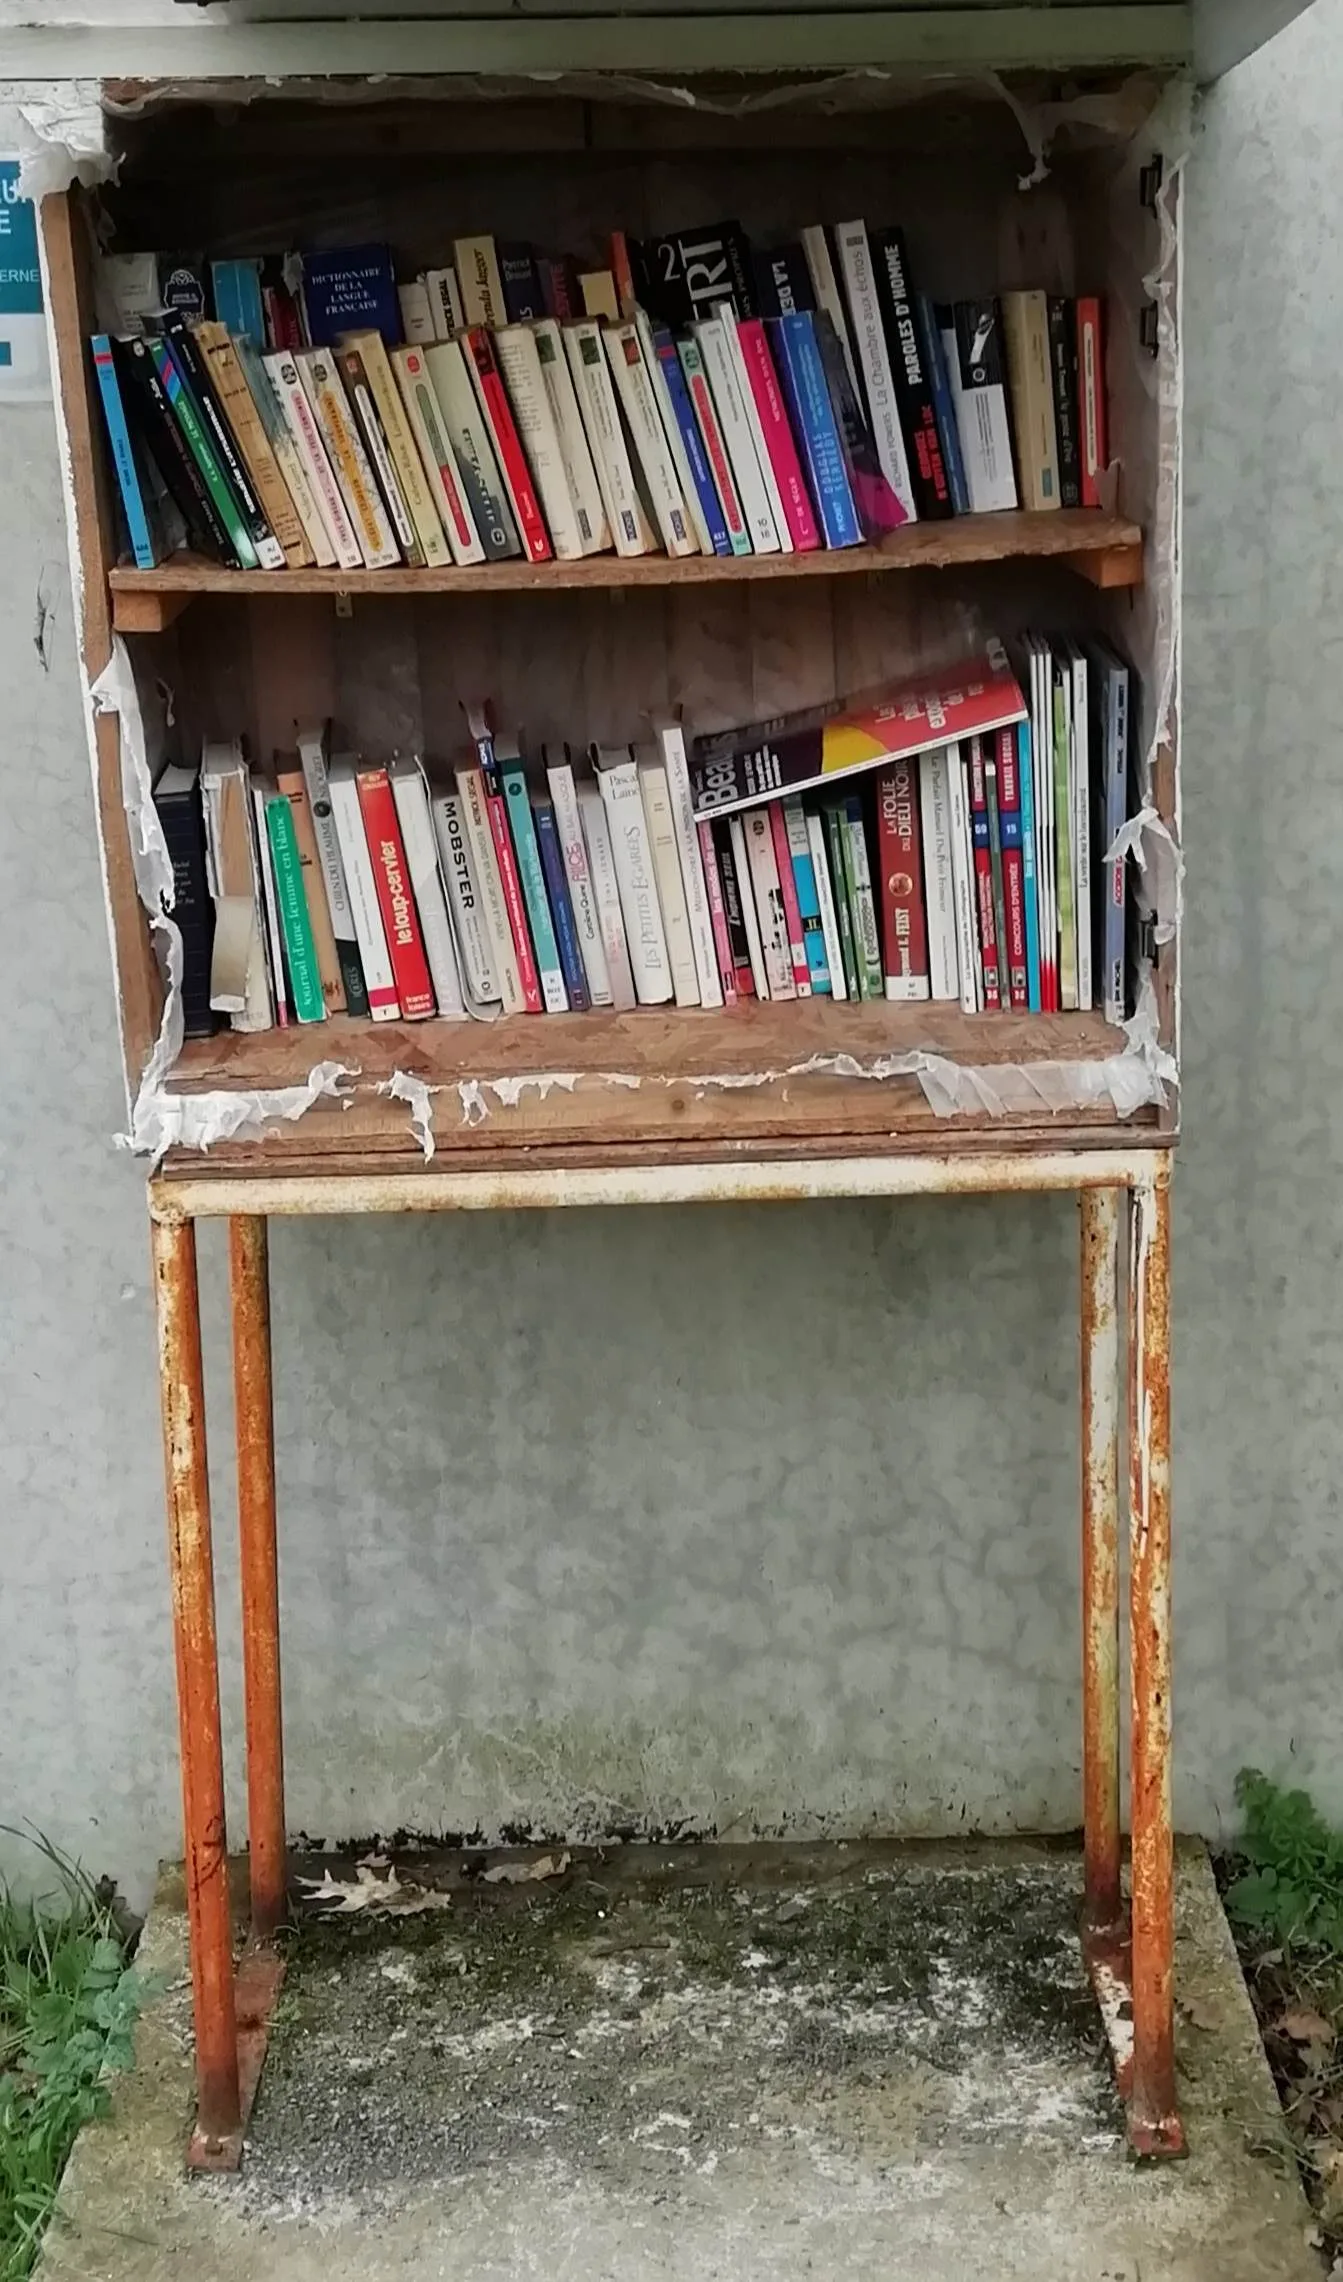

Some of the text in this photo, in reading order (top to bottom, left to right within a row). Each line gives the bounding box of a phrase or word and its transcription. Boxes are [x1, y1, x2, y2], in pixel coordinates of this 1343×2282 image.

[311, 267, 384, 286] DICTIONNAIRE
[657, 243, 681, 282] 2
[771, 261, 788, 285] LA
[852, 251, 867, 292] échos
[330, 289, 371, 304] LANGUE
[333, 280, 364, 293] DE LA
[861, 296, 872, 319] aux
[866, 325, 884, 385] Chambre
[898, 320, 921, 383] PAROLES
[876, 389, 887, 405] La
[895, 759, 909, 797] NOIR
[1002, 735, 1013, 800] TRAVAIL SOCIAL
[931, 770, 941, 800] Parfait
[882, 781, 897, 833] LA FOLIE
[897, 802, 911, 835] DIEU
[934, 802, 943, 834] Manuel
[276, 817, 287, 849] blanc
[282, 852, 291, 868] en
[445, 802, 473, 907] MOBSTER
[285, 873, 298, 918] femme
[381, 841, 412, 944] le loup-cervier
[580, 884, 588, 908] Quine
[708, 865, 719, 896] modes
[584, 908, 594, 939] Caroline
[895, 907, 909, 934] FEIST
[1012, 906, 1021, 954] CONCOURS
[292, 922, 304, 956] d'une
